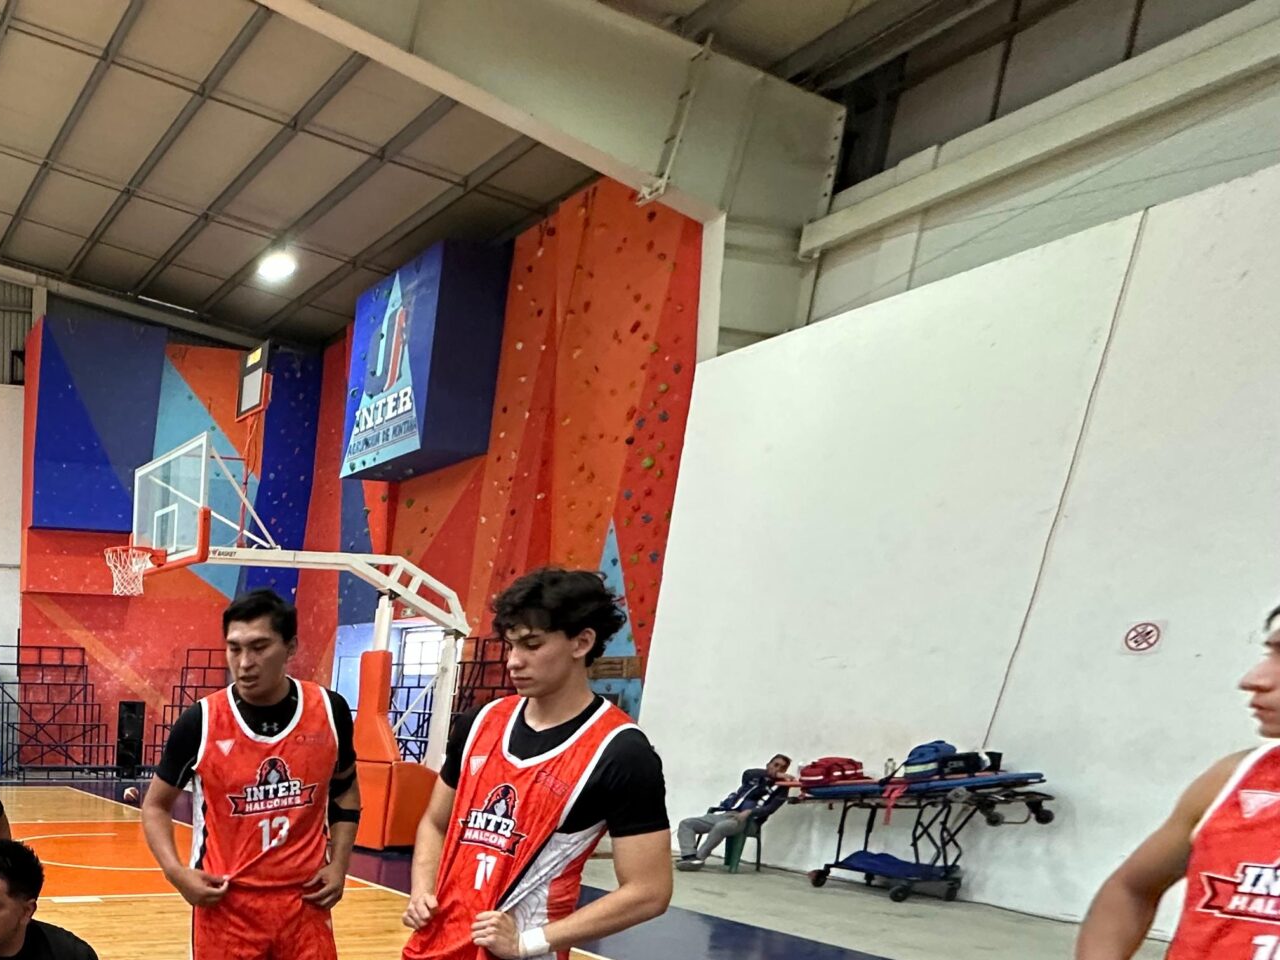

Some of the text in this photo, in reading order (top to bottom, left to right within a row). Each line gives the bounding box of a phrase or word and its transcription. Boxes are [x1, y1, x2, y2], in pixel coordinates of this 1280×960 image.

[354, 386, 413, 436] INTER
[246, 780, 301, 802] INTER
[245, 796, 301, 812] HALCONES
